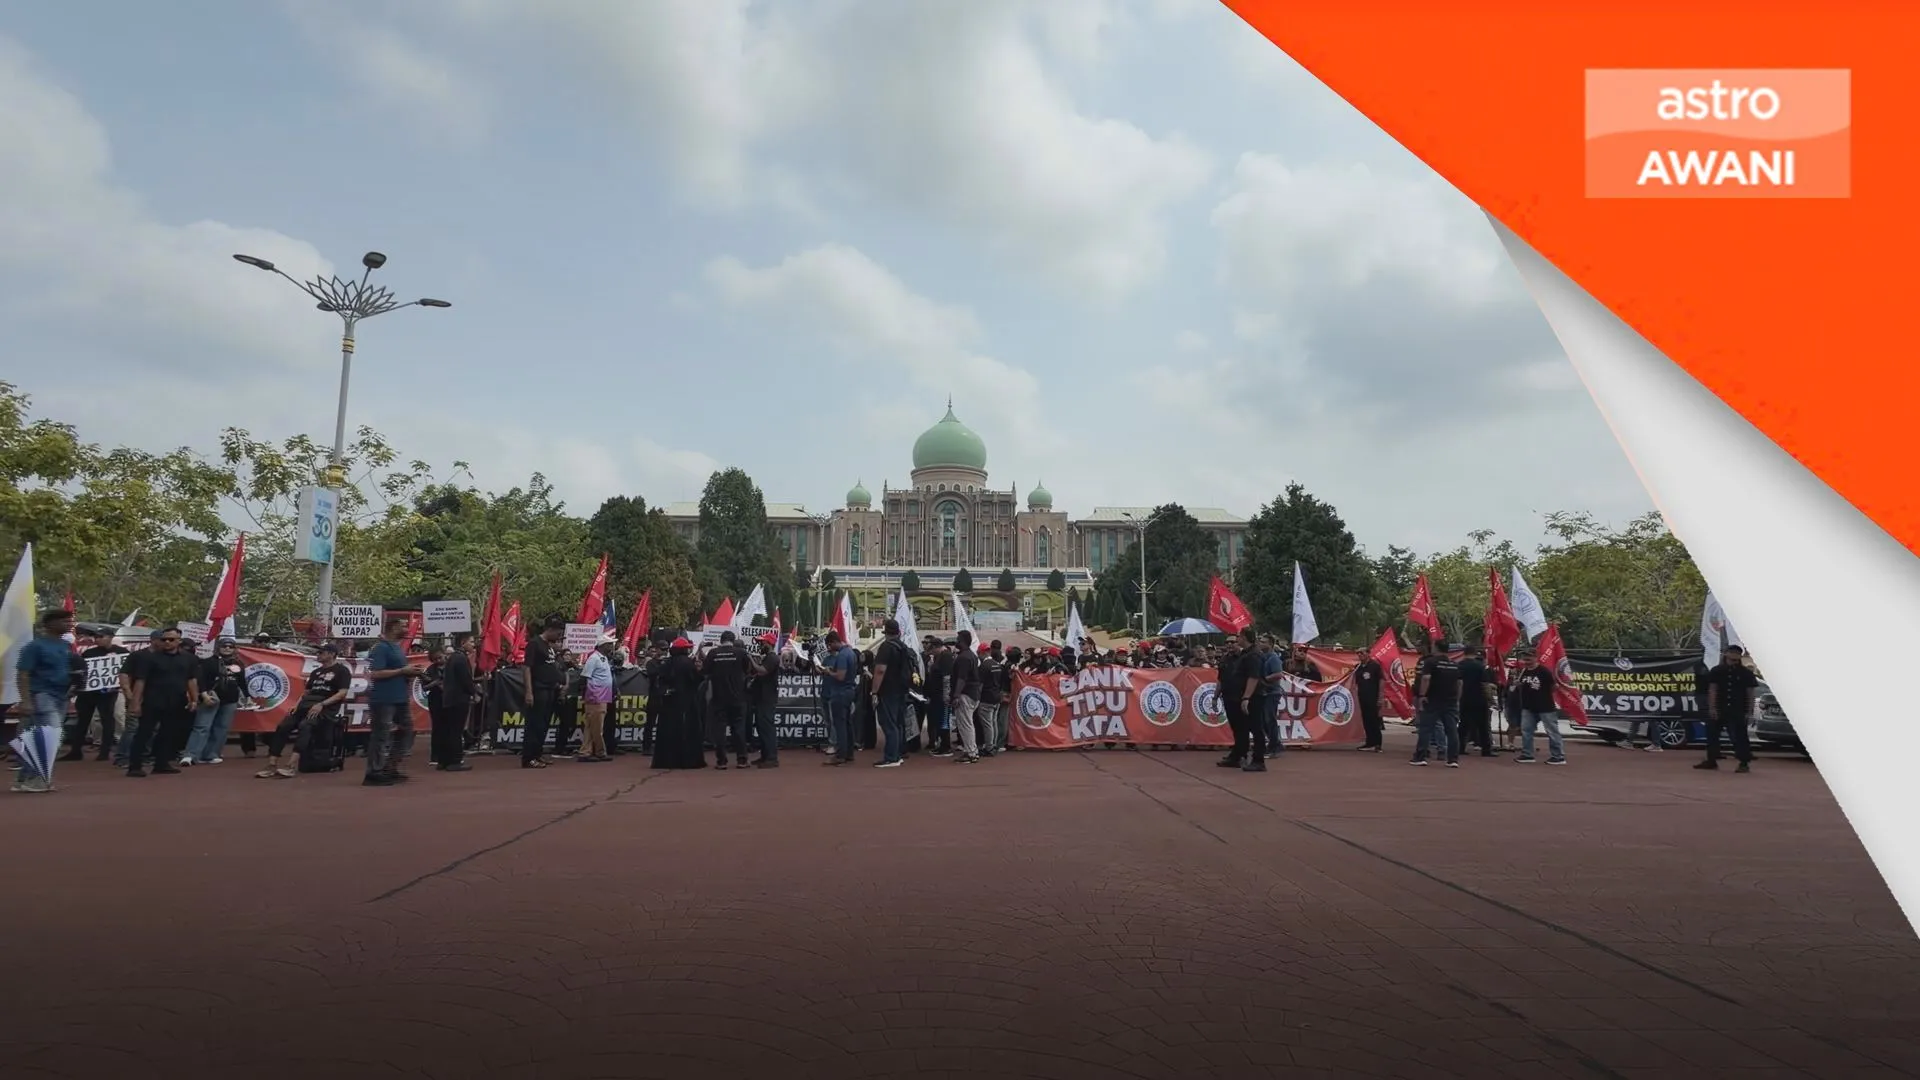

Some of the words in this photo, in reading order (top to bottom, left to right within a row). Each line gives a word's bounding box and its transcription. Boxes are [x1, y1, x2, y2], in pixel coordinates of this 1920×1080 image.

[338, 606, 375, 618] KESUMA,
[333, 616, 360, 626] KAMU
[360, 616, 380, 626] BELA
[341, 626, 371, 636] SIAPA?
[88, 676, 118, 689] OW
[1060, 667, 1134, 695] BANK
[1594, 673, 1634, 682] BREAK
[1636, 673, 1671, 682] LAWS
[1606, 682, 1678, 692] CORPORATE
[1616, 695, 1675, 712] STOP
[1277, 720, 1311, 740] TA
